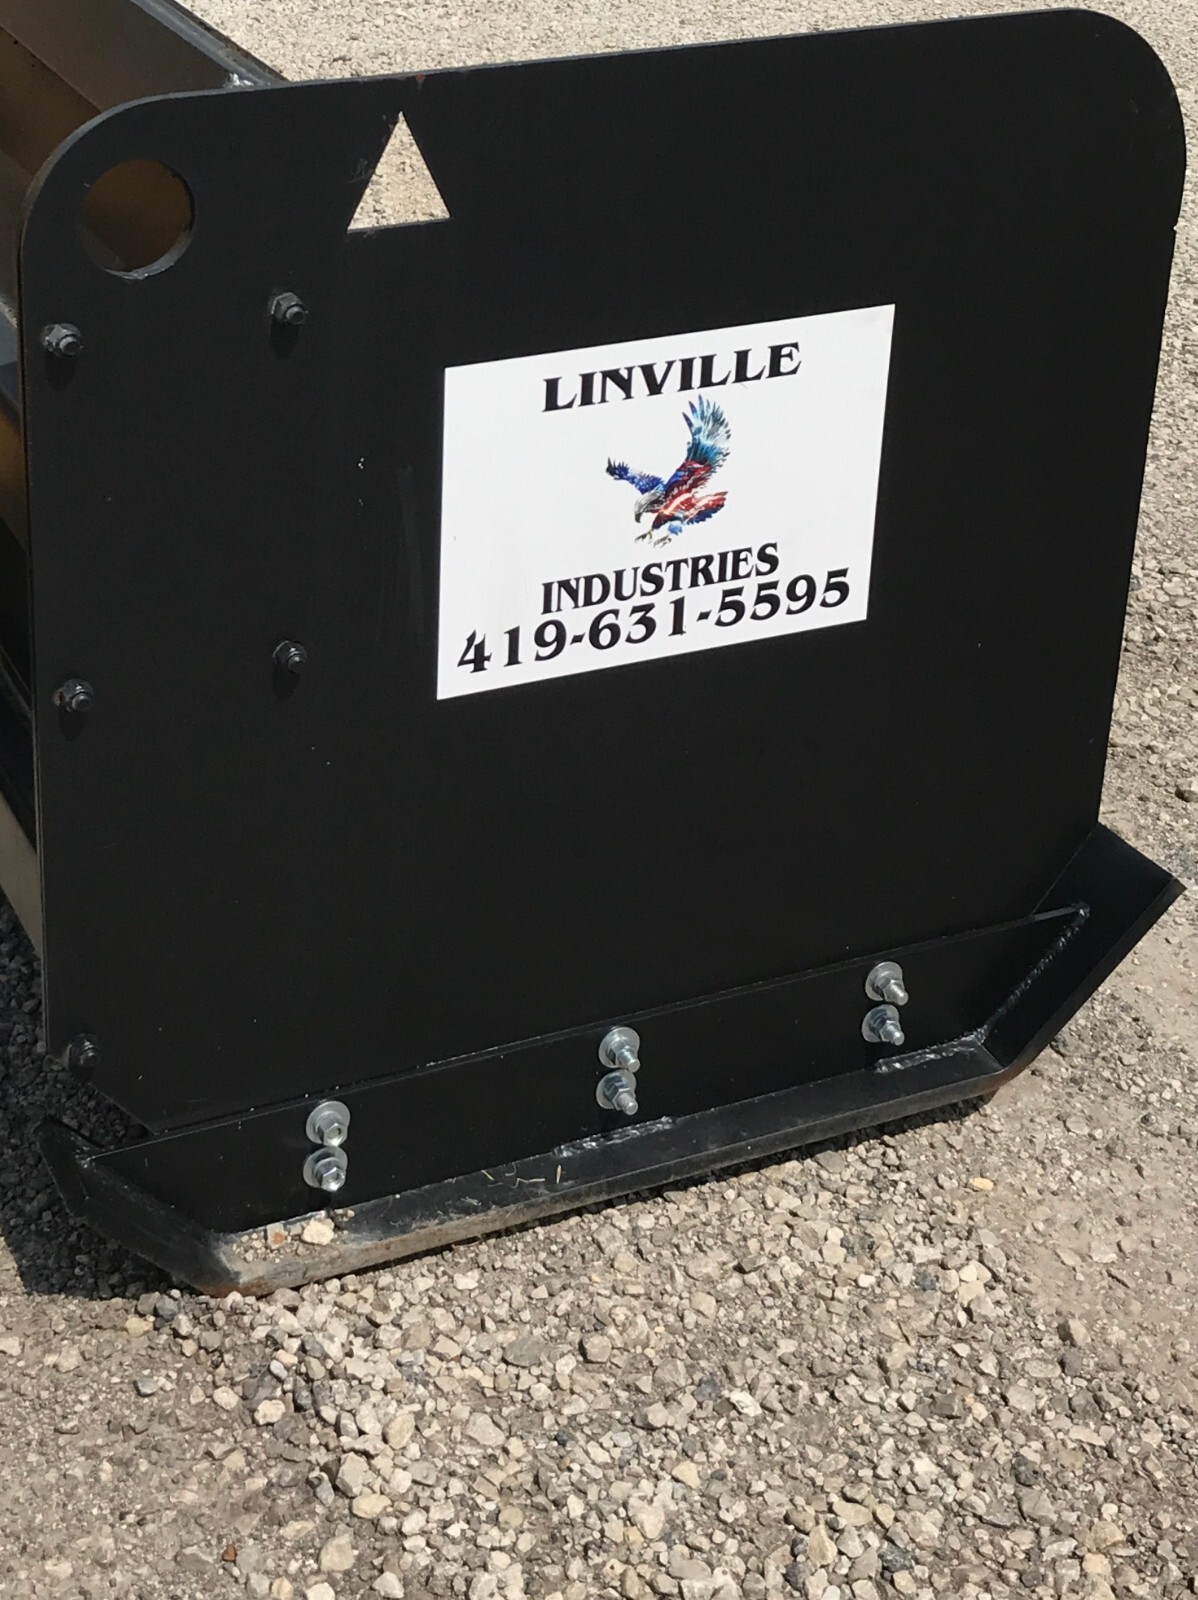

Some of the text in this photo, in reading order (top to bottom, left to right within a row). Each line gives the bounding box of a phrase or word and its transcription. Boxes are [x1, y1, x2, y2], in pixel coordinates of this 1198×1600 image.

[542, 342, 802, 412] LINVILLE
[540, 542, 779, 615] INDUSTRIES
[456, 567, 850, 674] 419-631-5595
